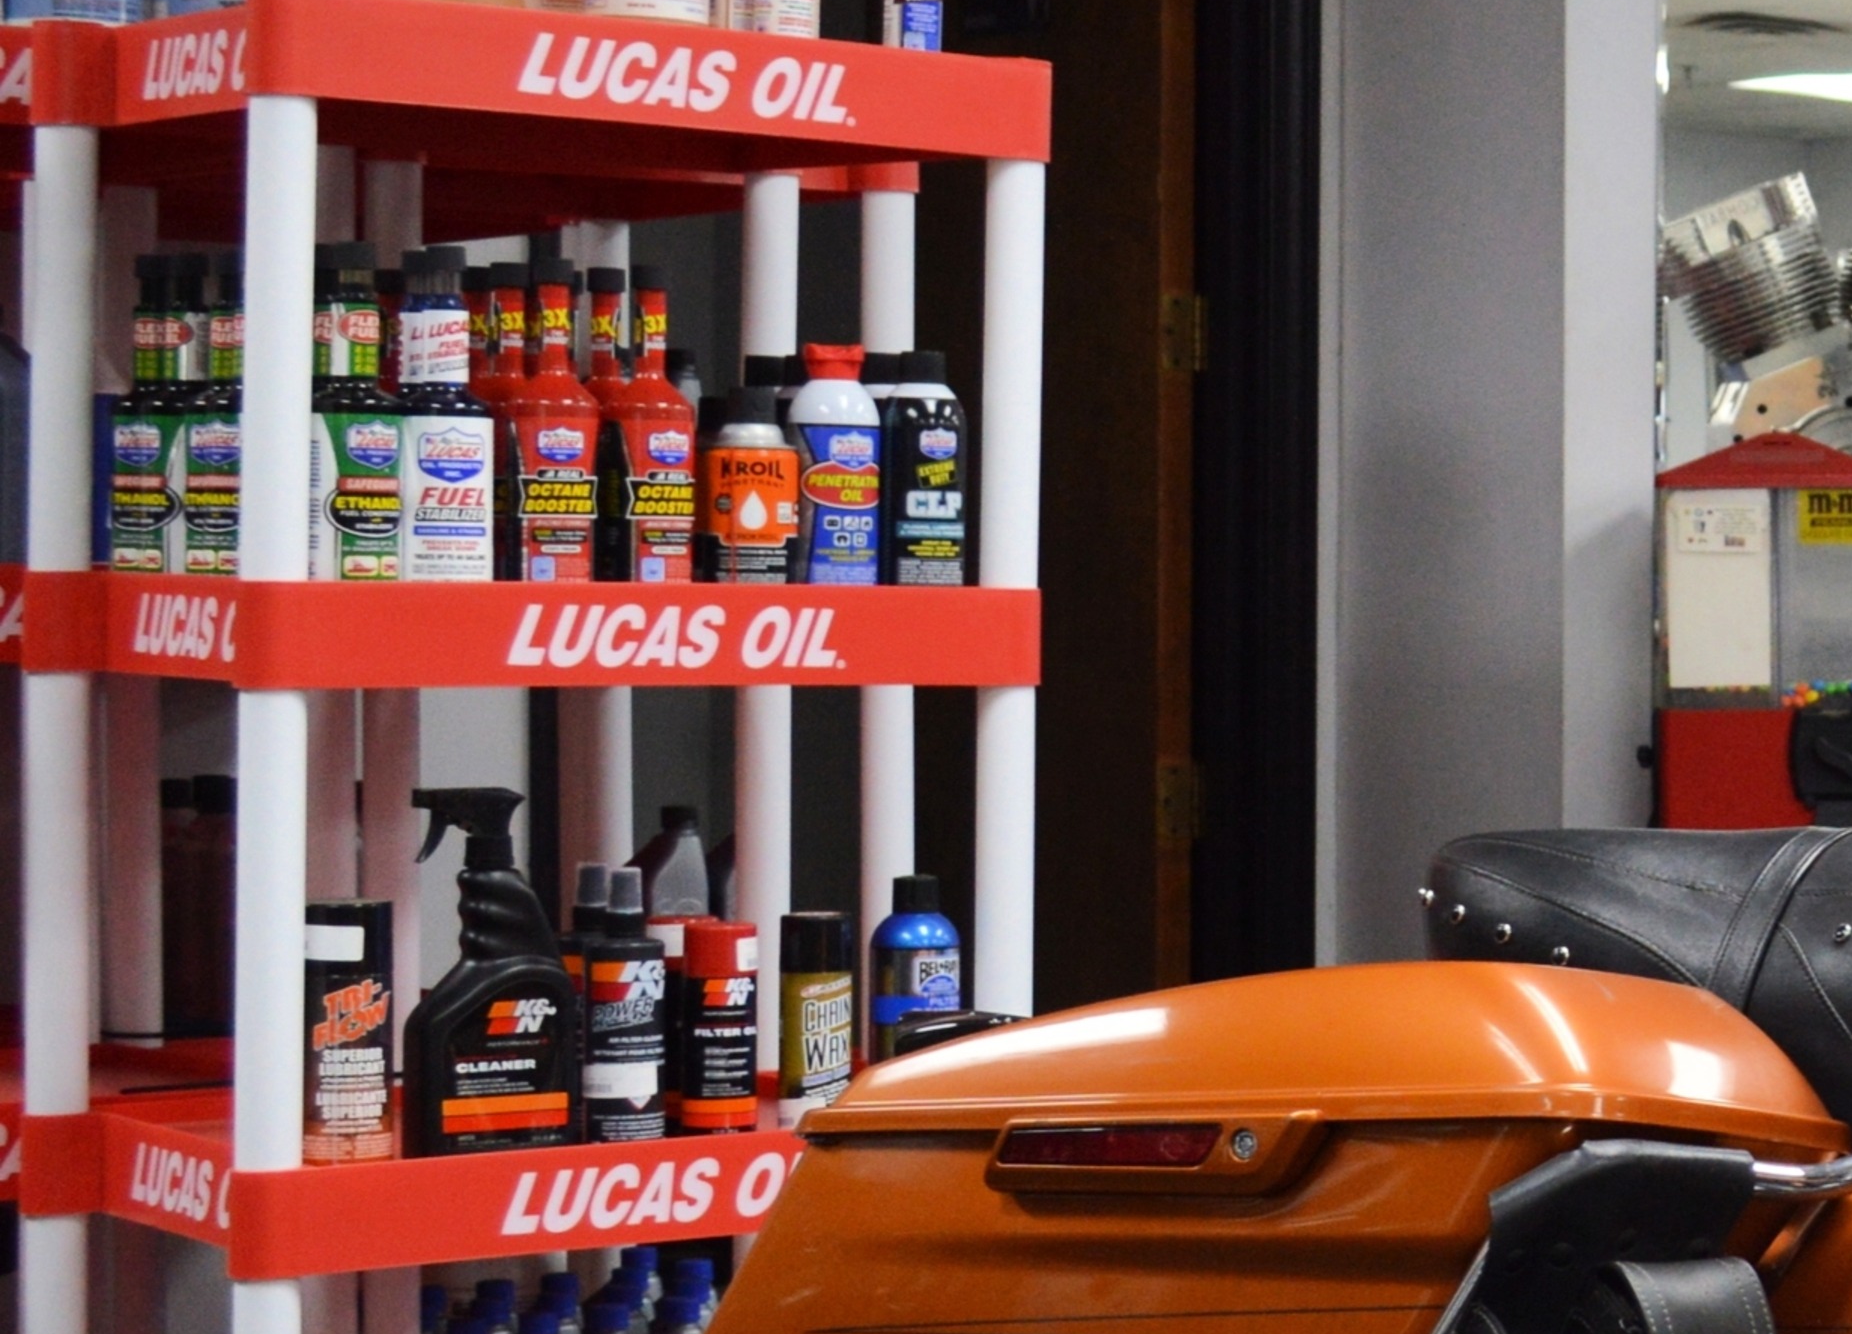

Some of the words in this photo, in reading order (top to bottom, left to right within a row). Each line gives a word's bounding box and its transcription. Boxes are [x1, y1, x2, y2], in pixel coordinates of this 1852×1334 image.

[142, 29, 229, 101] LUCAS
[517, 32, 737, 112] LUCAS
[501, 312, 525, 331] 3X
[543, 308, 571, 328] 3X
[645, 314, 667, 334] 3X
[425, 443, 481, 459] LUCAS
[720, 457, 785, 480] KROIL
[418, 486, 485, 506] FUEL
[528, 482, 590, 497] OCTANE
[840, 490, 865, 502] OIL
[525, 498, 593, 513] BOOSTER
[906, 490, 963, 518] CLP
[133, 592, 219, 661] LUCAS
[506, 603, 727, 669] LUCAS
[725, 977, 755, 1006] K&N
[512, 997, 557, 1033] K&N
[592, 996, 655, 1018] POWER
[803, 991, 851, 1034] CHAIN
[312, 991, 391, 1051] FLOW
[694, 1027, 741, 1037] FILTER
[804, 1028, 850, 1073] WAX
[455, 1059, 536, 1074] CLEANER
[131, 1142, 214, 1222] LUCAS
[501, 1157, 721, 1235] LUCAS
